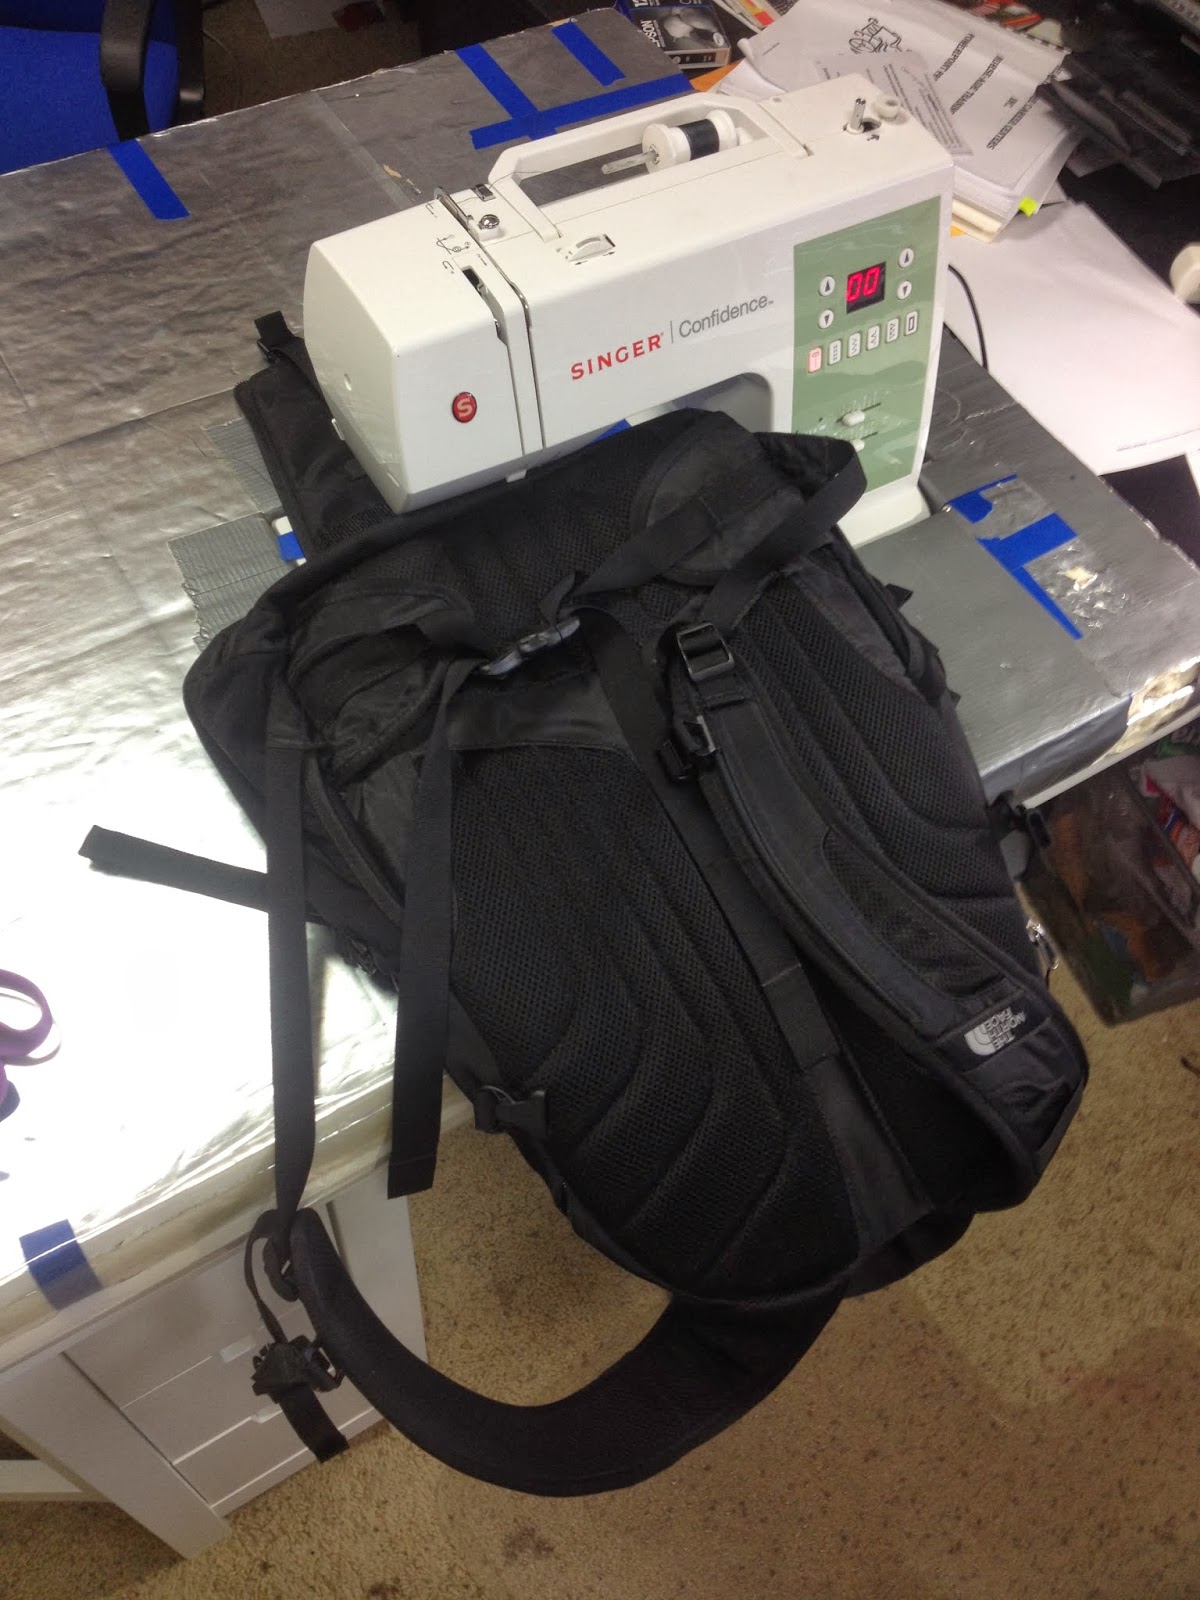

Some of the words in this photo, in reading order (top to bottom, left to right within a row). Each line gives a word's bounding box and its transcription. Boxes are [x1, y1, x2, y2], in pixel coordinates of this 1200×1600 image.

[940, 33, 975, 73] POWERPOINT
[986, 124, 1014, 150] CENTERS
[846, 265, 881, 303] 00
[570, 334, 662, 380] SINGER
[984, 1006, 1013, 1032] FACE
[988, 1010, 1026, 1037] NORTH
[992, 1031, 1016, 1051] THE
